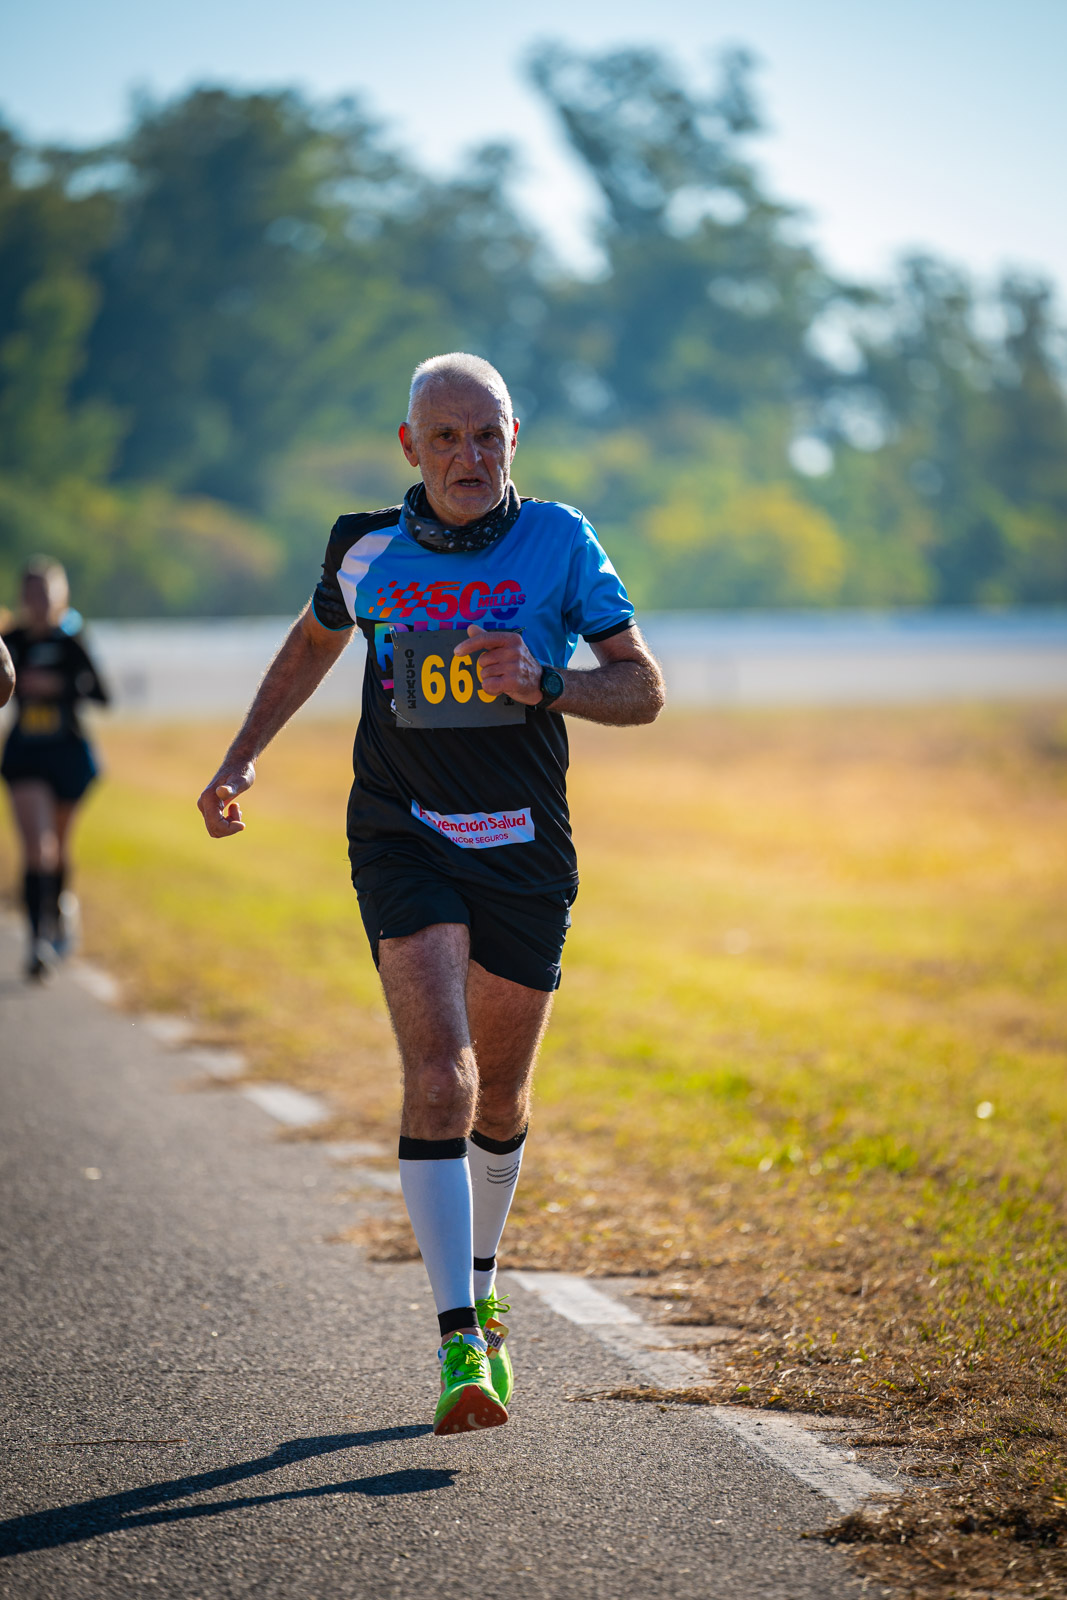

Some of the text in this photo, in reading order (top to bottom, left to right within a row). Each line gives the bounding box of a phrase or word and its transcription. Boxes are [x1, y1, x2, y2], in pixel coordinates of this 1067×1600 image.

[478, 593, 527, 608] MILLAS
[487, 813, 526, 830] Salud
[475, 833, 509, 844] SEGUROS
